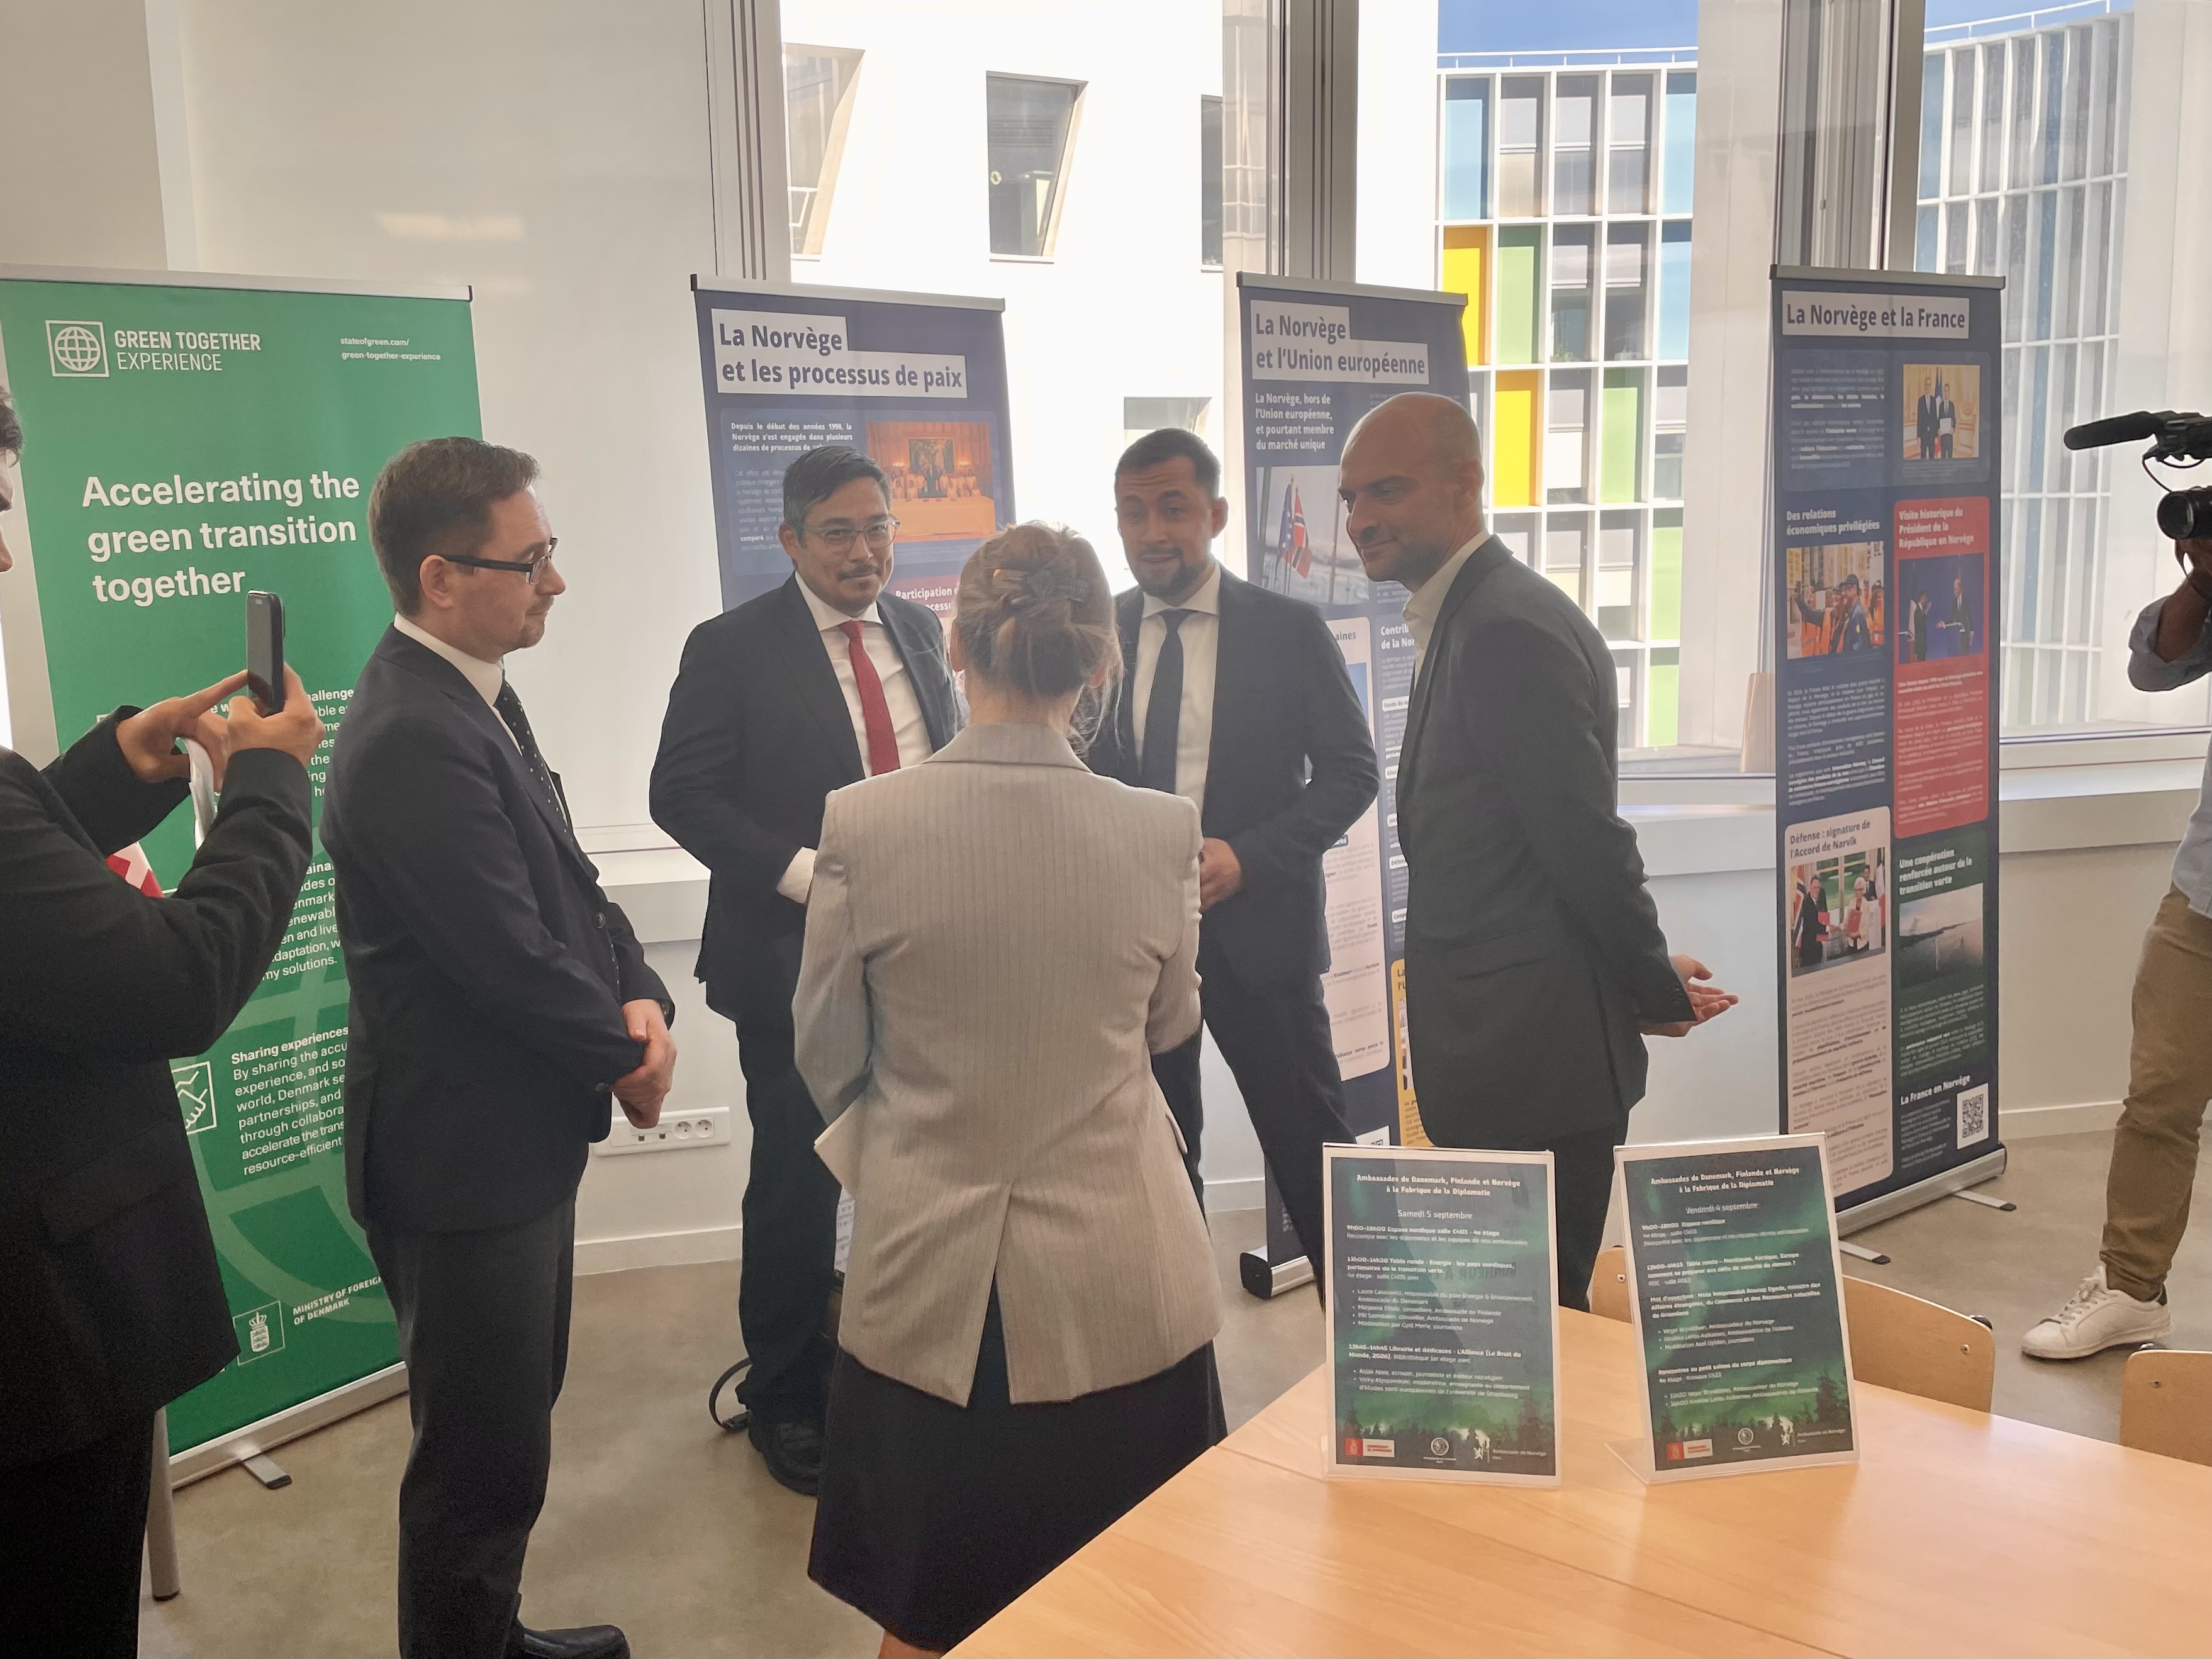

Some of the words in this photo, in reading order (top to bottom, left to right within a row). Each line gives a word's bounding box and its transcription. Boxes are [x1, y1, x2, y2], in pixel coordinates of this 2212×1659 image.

[1787, 303, 1804, 324] La
[1811, 304, 1877, 331] Norvège
[1881, 308, 1896, 326] et
[1901, 306, 1914, 327] la
[1918, 308, 1965, 328] France
[1256, 313, 1273, 335] La
[1280, 315, 1346, 345] Norvège
[115, 330, 171, 349] GREEN
[176, 331, 261, 351] TOGETHER
[340, 336, 410, 347] stateofgreen.com/
[720, 323, 745, 347] La
[752, 325, 843, 356] Norvège
[117, 352, 223, 371] EXPERIENCE
[342, 350, 441, 362] green-together-experience
[1256, 349, 1273, 369] et
[1278, 347, 1332, 371] l'Union
[1338, 352, 1425, 378] européenne
[722, 360, 745, 382] et
[752, 359, 783, 383] les
[789, 362, 890, 389] processus
[895, 364, 918, 386] de
[924, 366, 962, 393] paix
[1256, 393, 1265, 403] La
[1266, 393, 1302, 406] Norvège,
[1304, 393, 1320, 404] hors
[1321, 394, 1331, 404] de
[1256, 409, 1283, 419] l'Union
[1285, 409, 1332, 422] européenne,
[731, 423, 754, 432] Depuis
[1256, 425, 1264, 434] et
[1266, 425, 1302, 437] pourtant
[1304, 424, 1334, 435] membre
[732, 433, 760, 442] Norvège
[780, 433, 807, 442] engagée
[826, 433, 853, 442] plusieurs
[1256, 440, 1266, 450] du
[1268, 438, 1298, 450] marché
[1300, 439, 1326, 452] unique
[771, 445, 802, 453] processus
[82, 473, 303, 507] Accelerating
[310, 471, 360, 500] the
[1787, 510, 1800, 520] Des
[1802, 509, 1836, 521] relations
[1899, 510, 1918, 520] Visite
[1919, 508, 1953, 522] historique
[1954, 507, 1963, 517] du
[1786, 522, 1837, 536] économiques
[1838, 520, 1880, 534] privilégiées
[1899, 523, 1931, 534] Président
[1933, 522, 1941, 532] de
[1942, 522, 1948, 532] la
[87, 526, 192, 562] green
[199, 515, 357, 549] transition
[1899, 535, 1937, 549] République
[1938, 536, 1947, 545] en
[1948, 533, 1974, 545] Norvège
[92, 567, 246, 606] together
[1382, 639, 1390, 650] de
[1392, 639, 1399, 648] la
[1790, 830, 1820, 844] Défense
[1826, 823, 1860, 839] signature
[1862, 820, 1870, 830] de
[1790, 844, 1820, 859] l'Accord
[1821, 841, 1831, 852] de
[1833, 837, 1857, 849] Narvik
[1899, 858, 1913, 869] Une
[1966, 856, 1972, 866] la
[1899, 881, 1933, 895] transition
[297, 926, 316, 940] and
[283, 956, 337, 976] solutions.
[232, 1046, 279, 1064] Sharing
[281, 1027, 349, 1051] experiences
[233, 1069, 249, 1081] By
[252, 1057, 298, 1076] sharing
[300, 1050, 318, 1063] the
[235, 1071, 306, 1097] experience,
[308, 1060, 328, 1076] and
[236, 1093, 276, 1112] world,
[277, 1076, 330, 1101] Denmark
[1901, 1095, 1909, 1105] La
[1910, 1088, 1932, 1102] France
[1933, 1085, 1942, 1093] en
[1943, 1075, 1970, 1091] Norvège
[238, 1098, 318, 1131] partnerships,
[320, 1088, 341, 1104] and
[240, 1121, 289, 1144] through
[242, 1136, 300, 1160] accelerate
[301, 1129, 319, 1141] the
[243, 1137, 343, 1176] resource-efficient
[1357, 1174, 1399, 1182] Ambassades
[1411, 1176, 1448, 1185] Danemark,
[1450, 1177, 1480, 1185] Finlande
[1492, 1178, 1521, 1188] Norvège
[1651, 1176, 1690, 1185] Ambassades
[1701, 1172, 1734, 1180] Danemark,
[1736, 1170, 1763, 1178] Finlande
[1401, 1186, 1431, 1195] Fabrique
[1453, 1188, 1491, 1196] Diplomatie
[1692, 1183, 1719, 1192] Fabrique
[1739, 1180, 1774, 1188] Diplomatie
[1397, 1209, 1424, 1218] Samedi
[1434, 1211, 1472, 1220] septembre
[1685, 1205, 1714, 1214] Vendredi
[1723, 1202, 1758, 1212] septembre
[293, 1293, 334, 1315] MINISTRY
[335, 1288, 347, 1299] OF
[294, 1315, 305, 1326] OF
[307, 1298, 350, 1320] DENMARK
